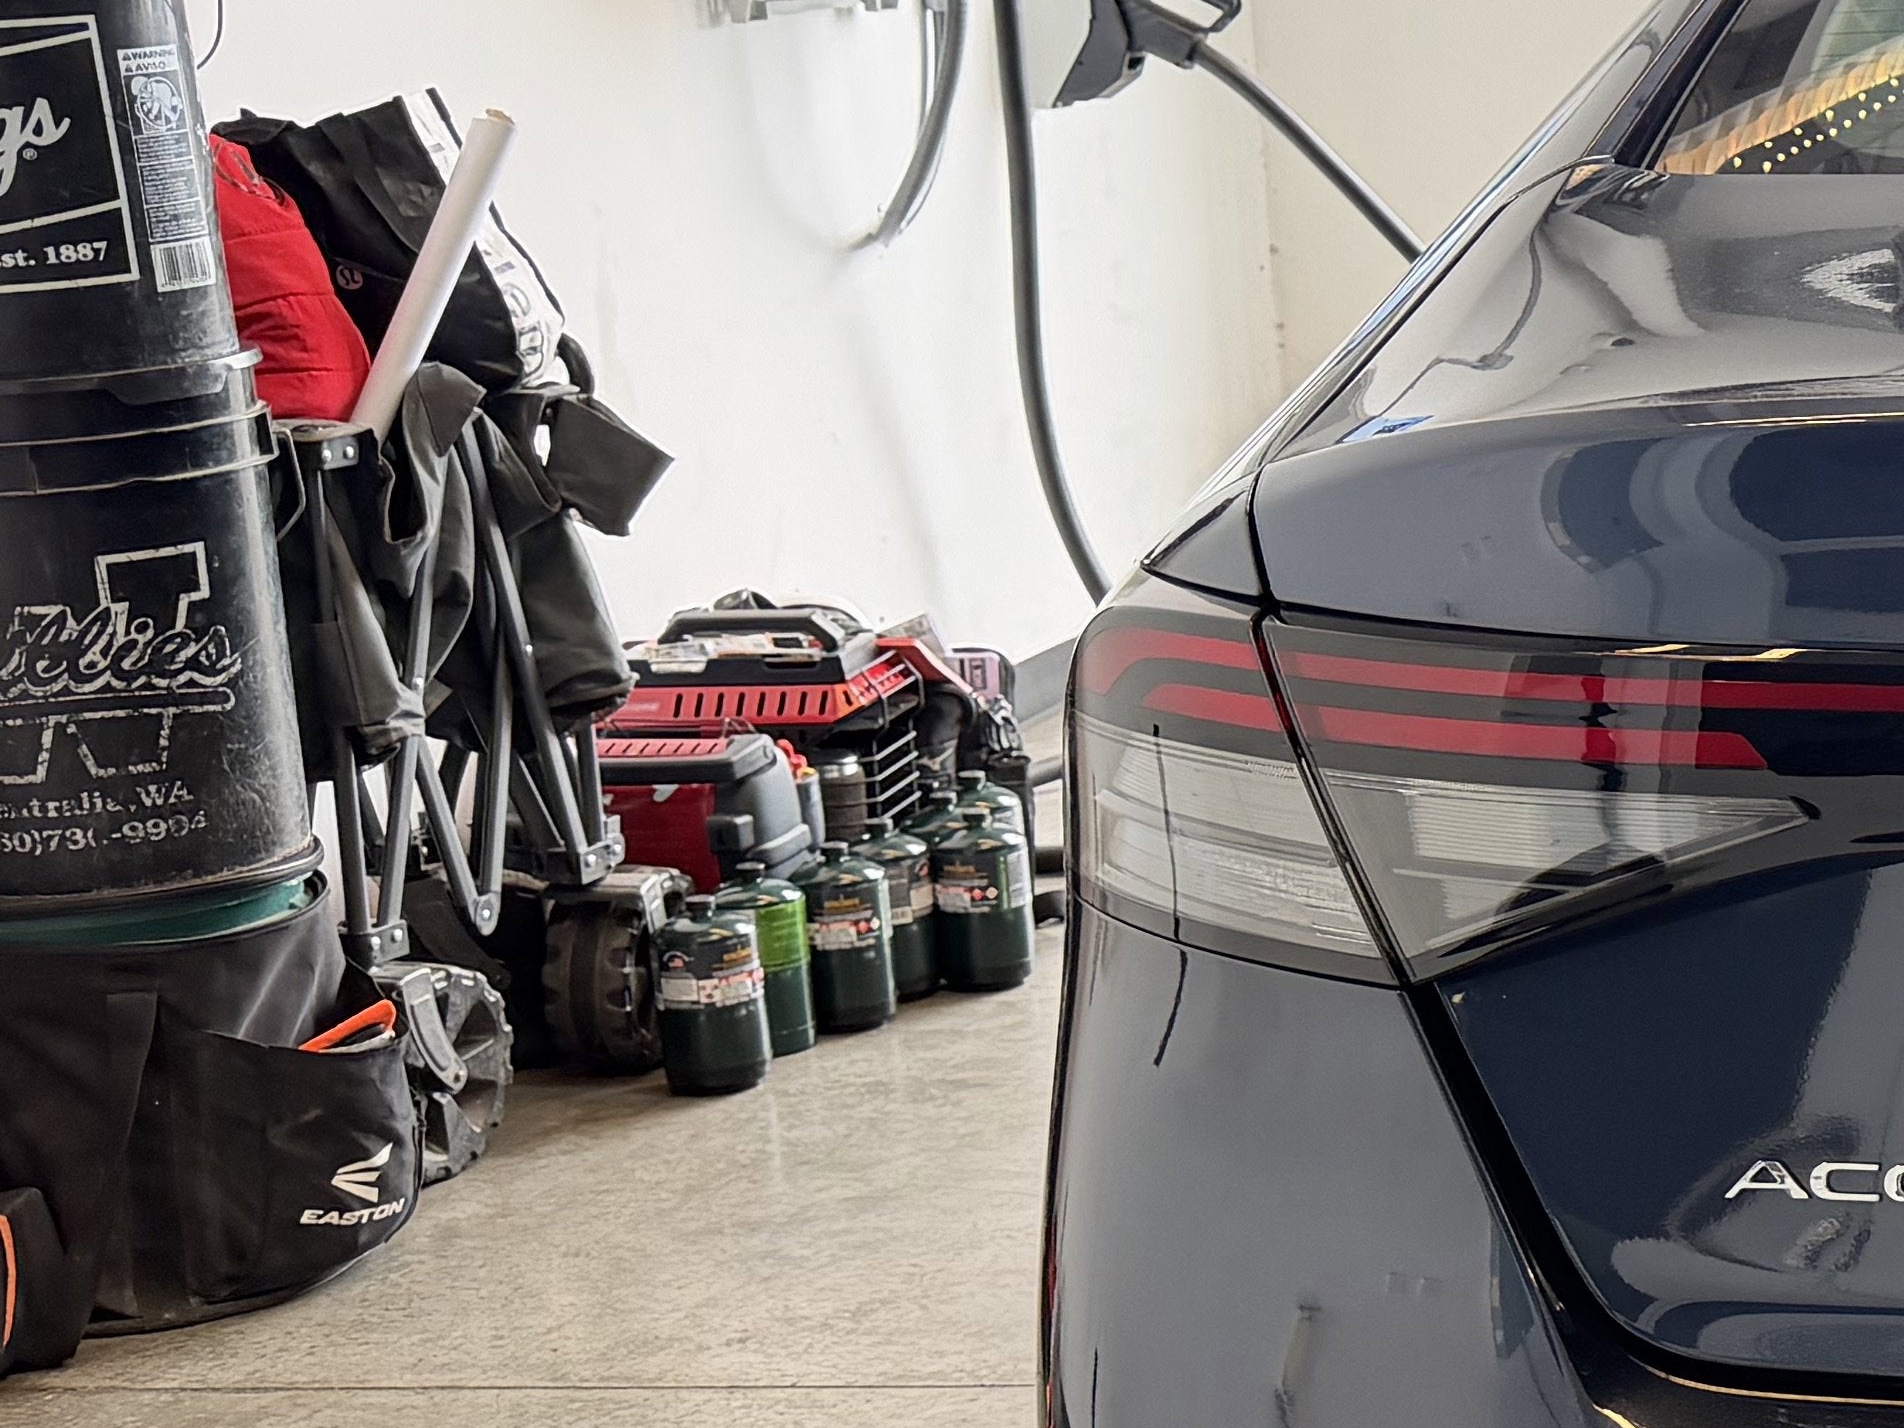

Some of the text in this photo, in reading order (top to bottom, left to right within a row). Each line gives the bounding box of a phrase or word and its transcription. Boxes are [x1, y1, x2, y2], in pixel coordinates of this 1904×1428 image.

[0, 241, 108, 267] st. 1887
[136, 780, 195, 808] WA
[299, 1197, 405, 1225] EASTON
